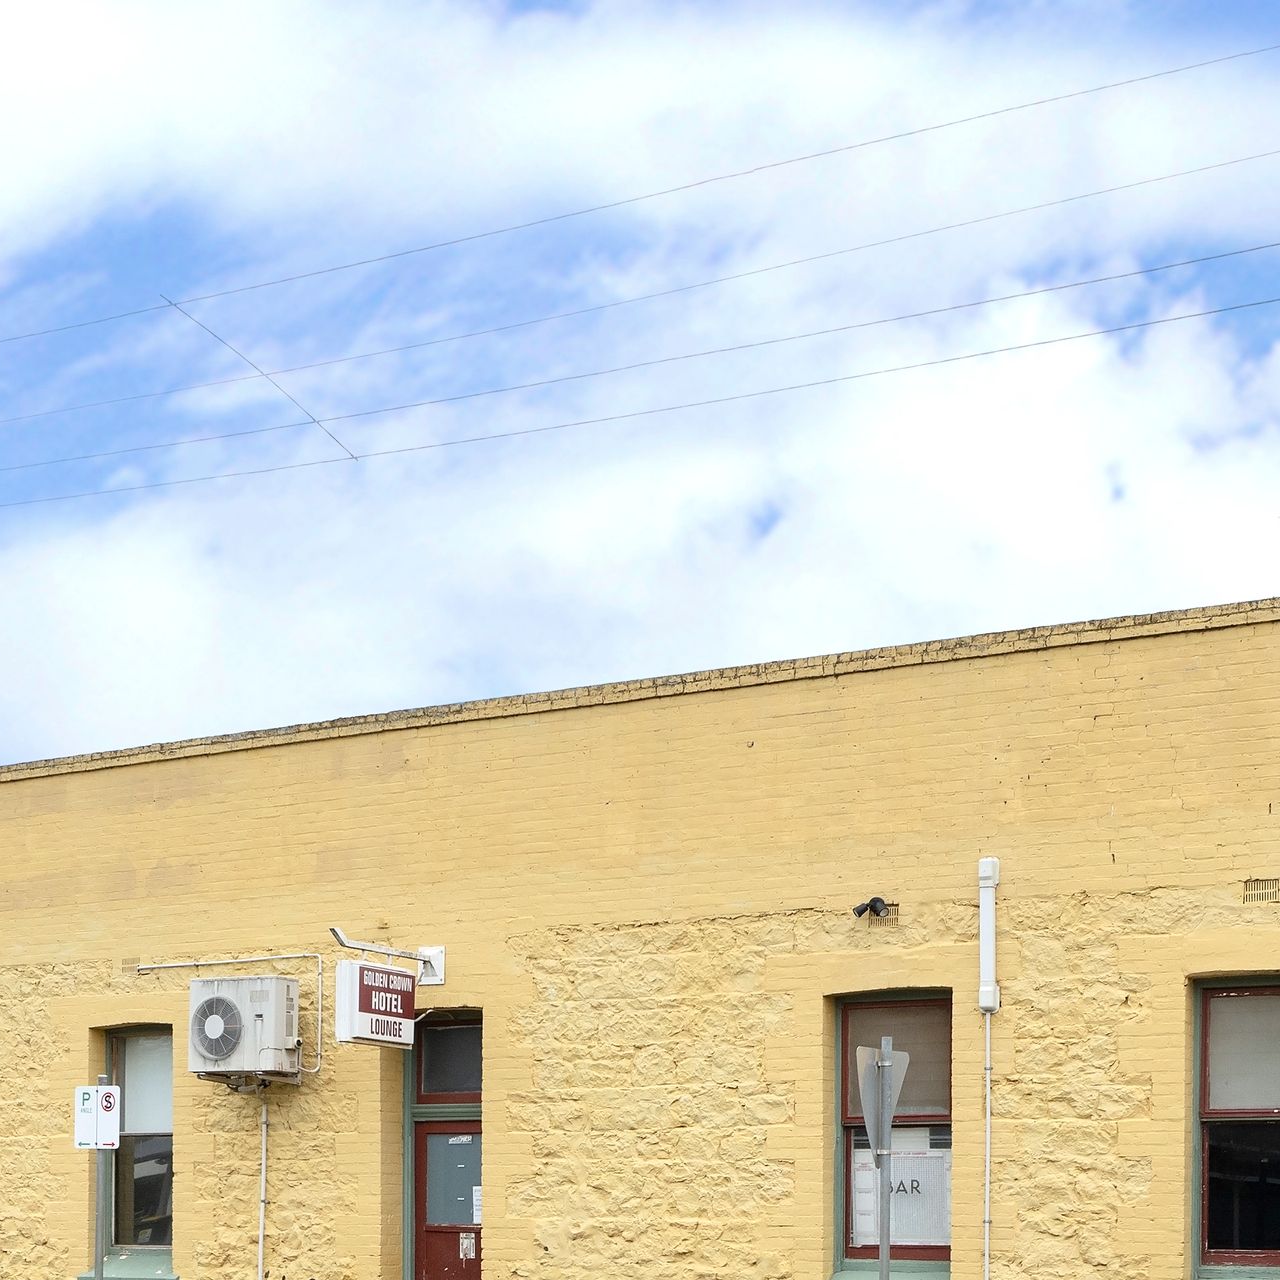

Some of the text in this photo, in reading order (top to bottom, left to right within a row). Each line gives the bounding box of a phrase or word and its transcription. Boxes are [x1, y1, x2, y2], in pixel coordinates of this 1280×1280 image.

[363, 970, 413, 992] GOLDEN CROWN
[372, 991, 404, 1014] HOTEL
[370, 1018, 403, 1038] LOUNGE
[82, 1092, 91, 1106] P
